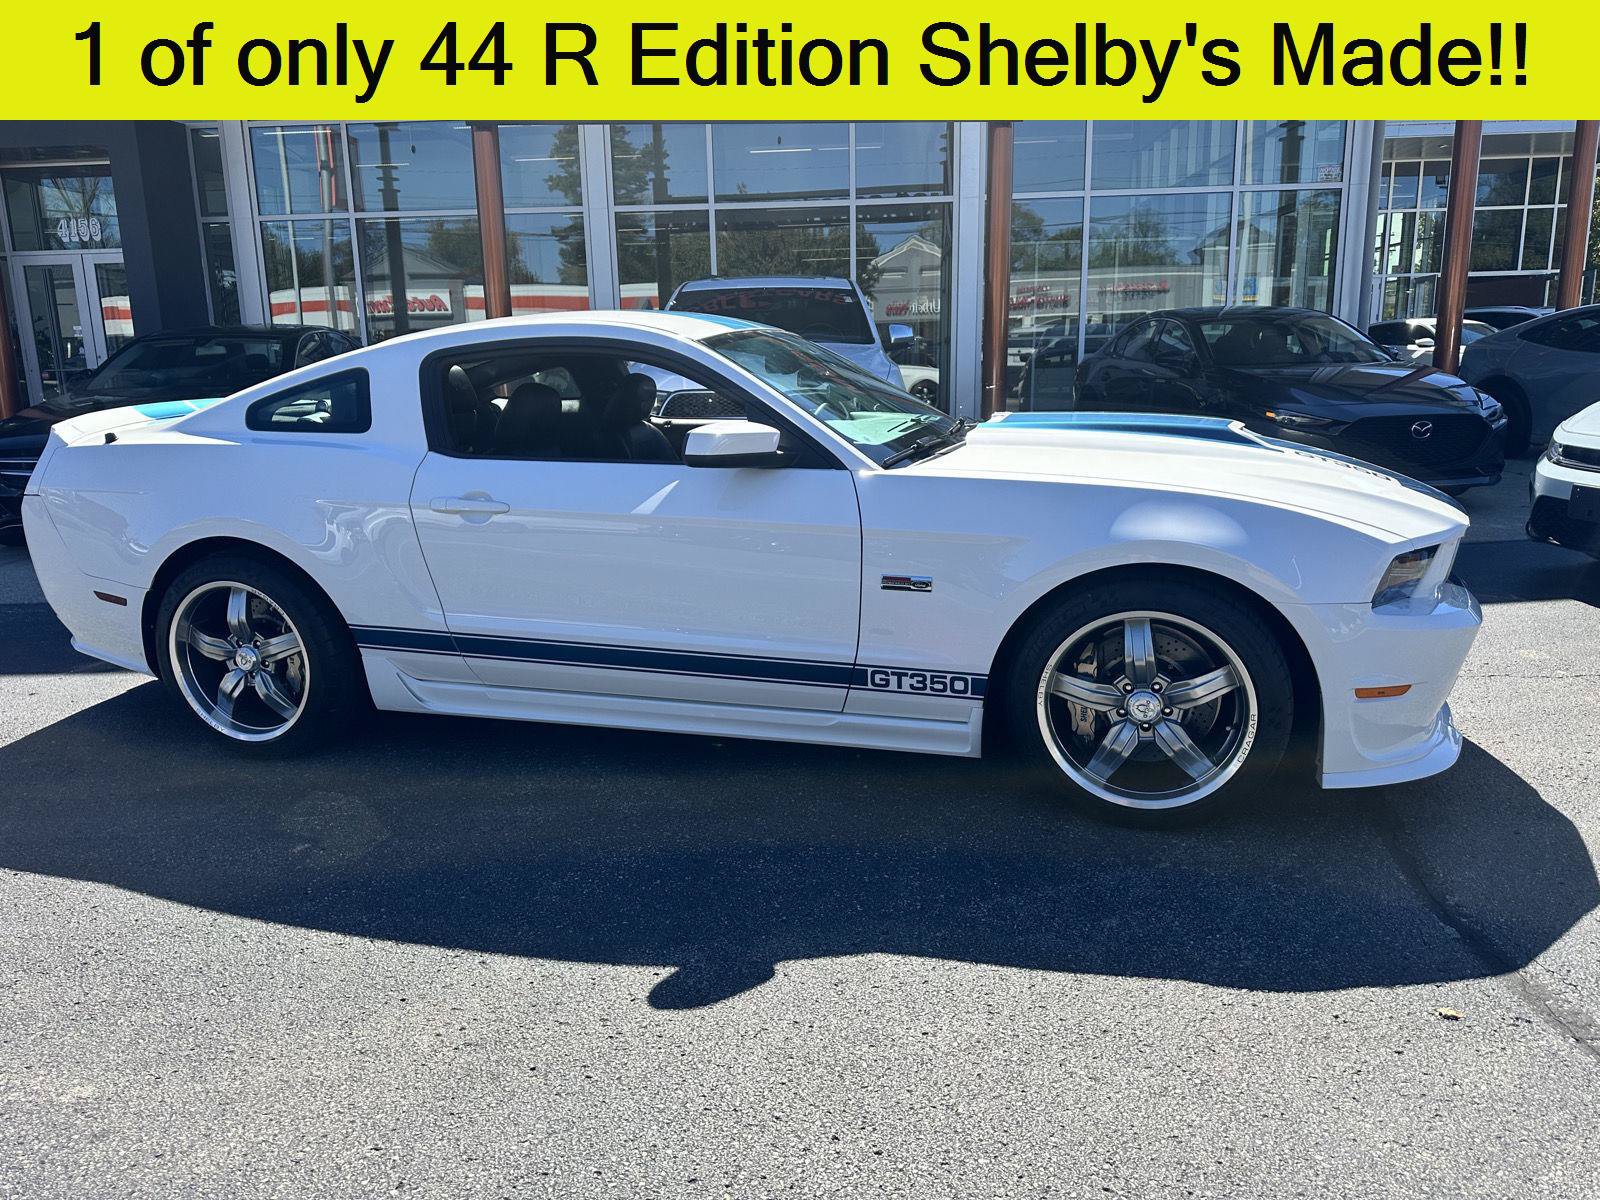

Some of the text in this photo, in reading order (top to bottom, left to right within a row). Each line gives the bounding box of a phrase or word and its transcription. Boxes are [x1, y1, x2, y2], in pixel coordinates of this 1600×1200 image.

[57, 217, 101, 242] 4156
[869, 669, 970, 695] GT350
[1038, 663, 1053, 707] SHELBY
[1237, 713, 1257, 763] CRAGAR
